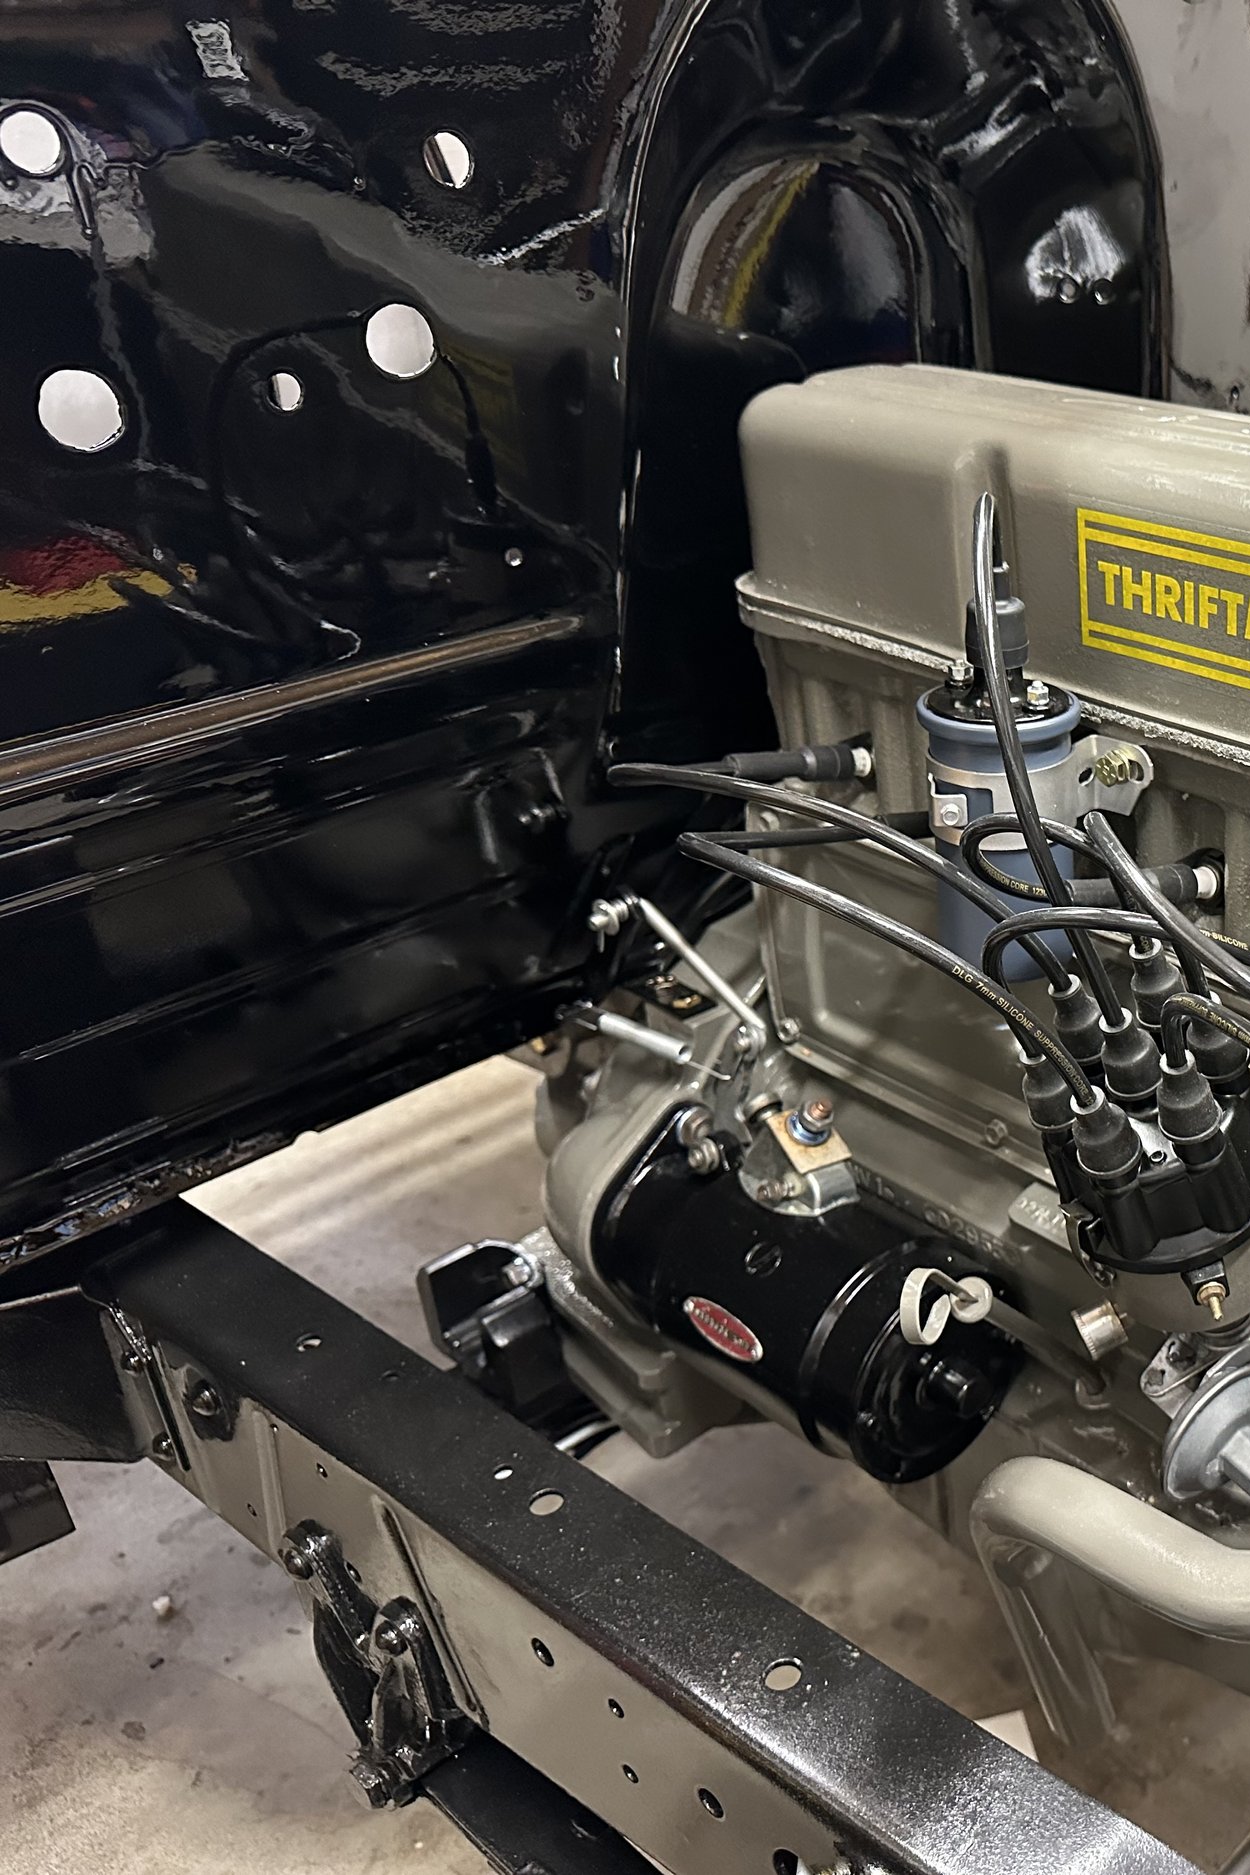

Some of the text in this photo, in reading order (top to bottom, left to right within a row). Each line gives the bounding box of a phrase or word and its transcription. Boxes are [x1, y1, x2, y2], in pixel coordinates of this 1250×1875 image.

[1010, 880, 1029, 893] CORE
[952, 964, 974, 984] DLG
[975, 980, 997, 1001] 7mm
[997, 997, 1034, 1031] SILICONE
[1034, 1029, 1078, 1078] SUPPRESSION
